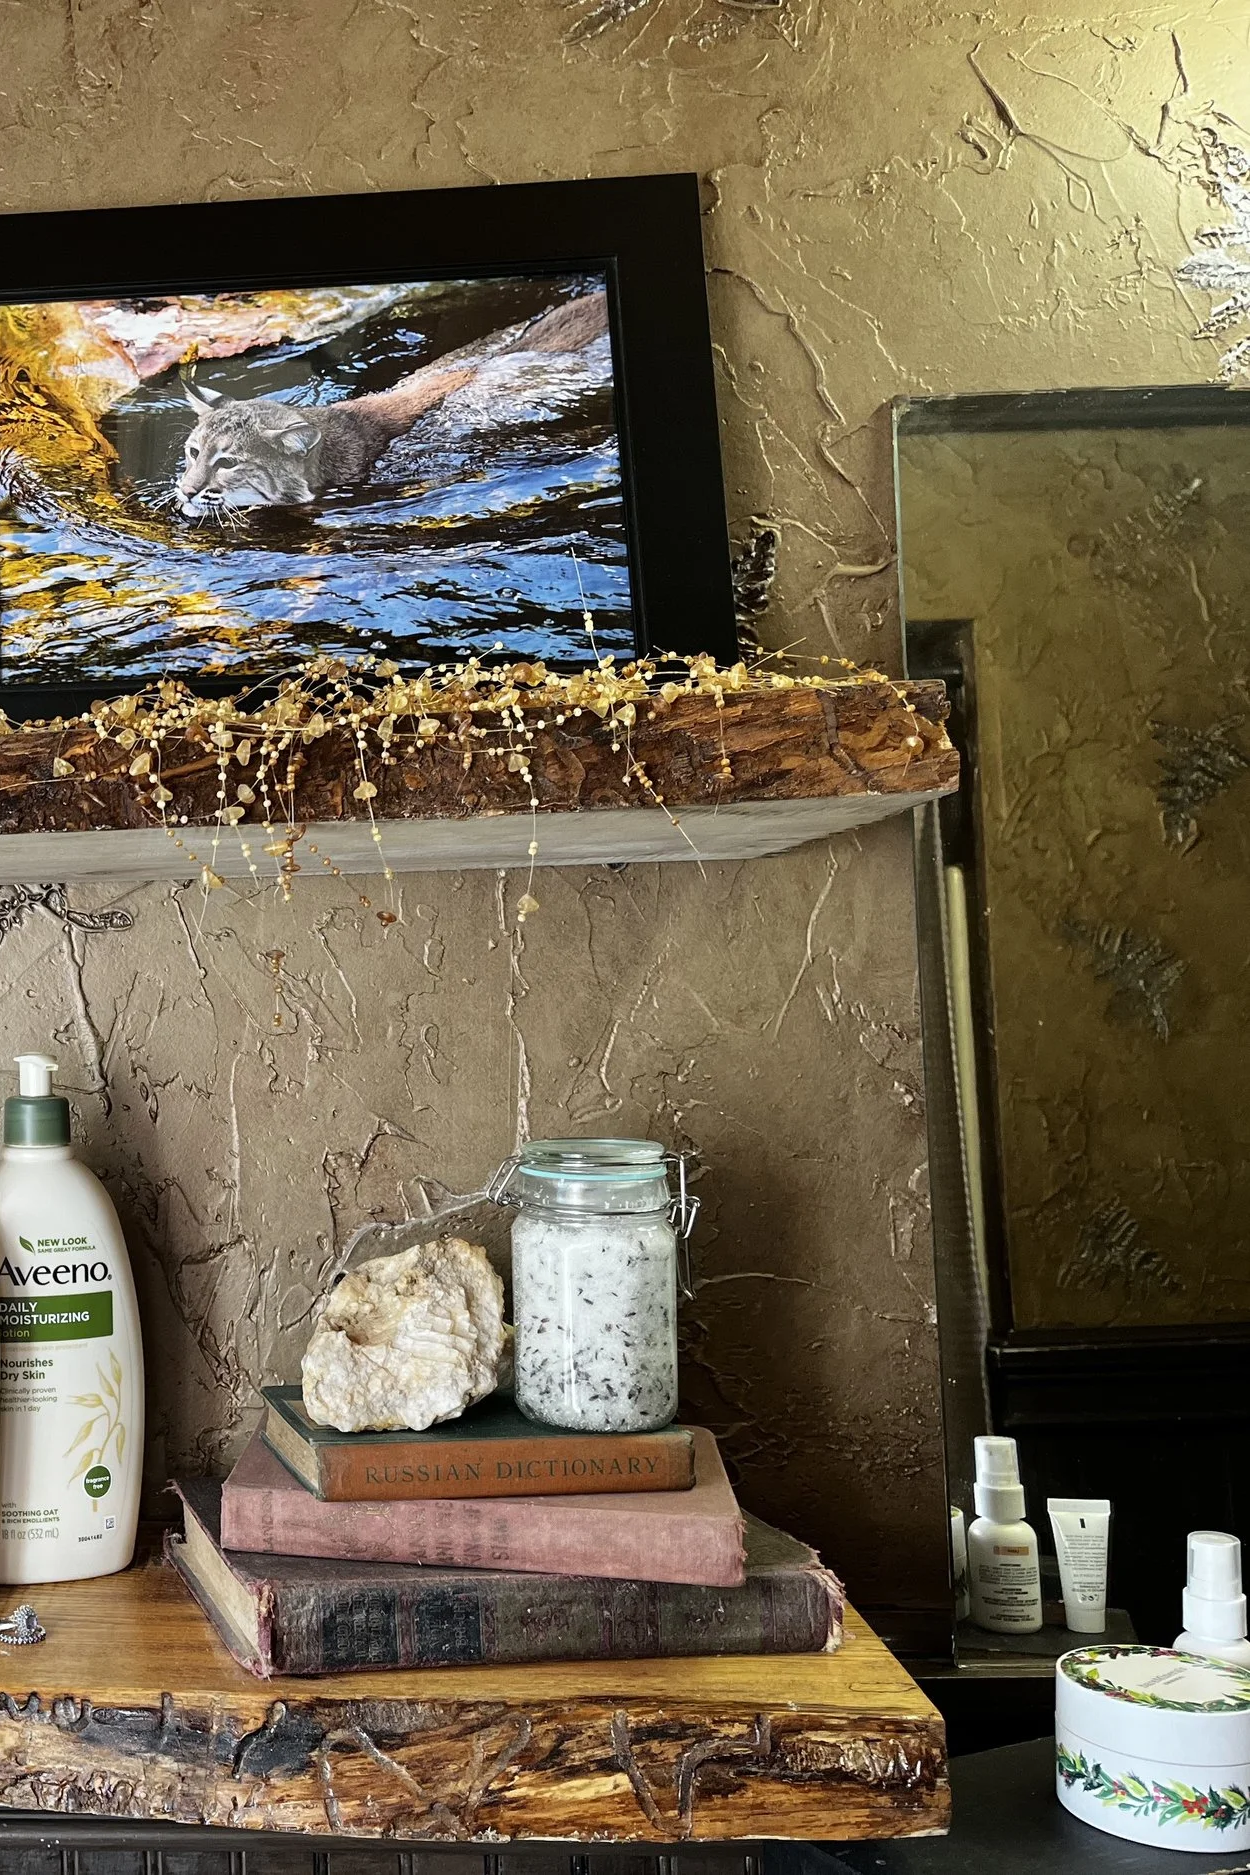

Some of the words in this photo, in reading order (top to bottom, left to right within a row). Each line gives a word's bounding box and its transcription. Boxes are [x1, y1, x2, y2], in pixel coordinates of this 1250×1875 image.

[37, 1239, 60, 1247] NEW
[62, 1237, 87, 1246] LOOK
[0, 1302, 38, 1313] DAILY
[0, 1311, 90, 1325] MOISTURIZING
[1, 1329, 30, 1338] otion
[0, 1358, 54, 1368] Nourishes
[0, 1371, 19, 1381] Dry
[22, 1370, 45, 1380] Skin
[32, 1386, 56, 1395] proven
[27, 1405, 41, 1414] day
[365, 1463, 482, 1484] RUSSIAN
[497, 1456, 661, 1480] DICTIONARY
[85, 1475, 110, 1484] fragrance
[1, 1509, 42, 1517] SOOTHING
[43, 1508, 58, 1516] OAT
[1, 1529, 9, 1540] 18
[10, 1529, 16, 1540] fl
[17, 1530, 26, 1540] oz
[27, 1529, 44, 1540] (532
[45, 1528, 60, 1540] mL)
